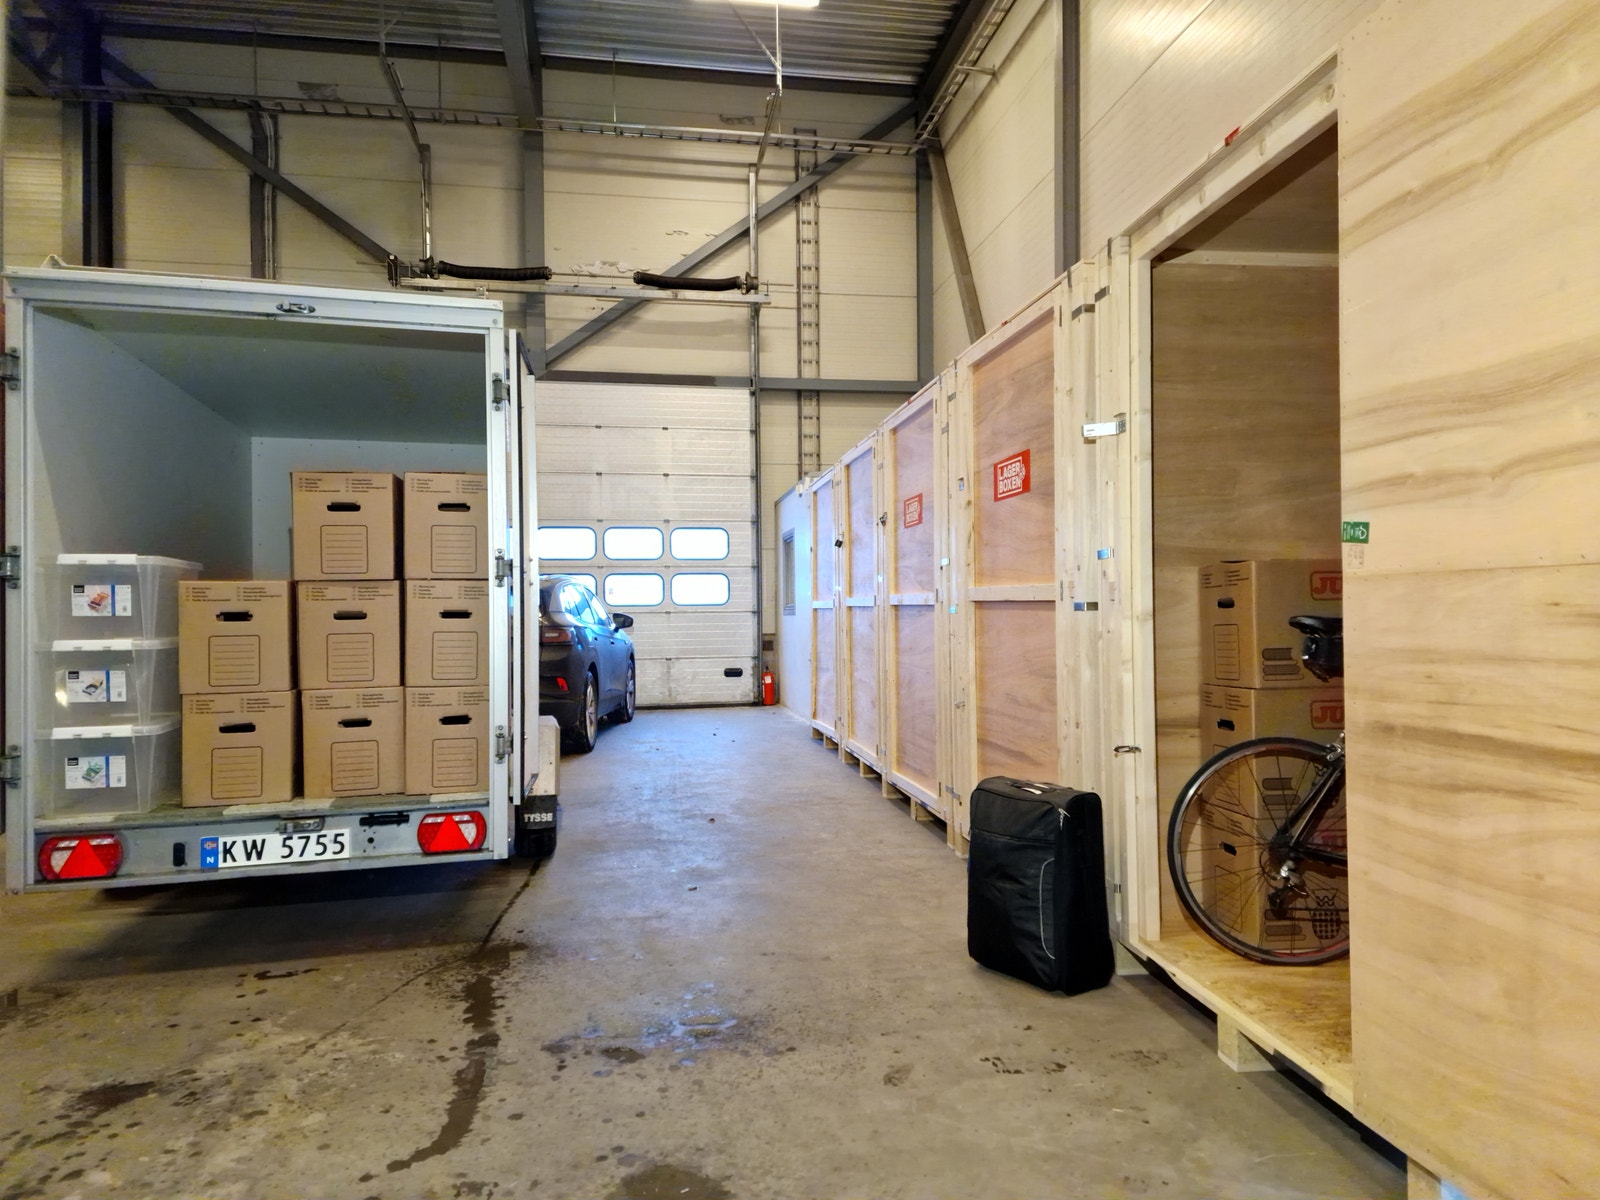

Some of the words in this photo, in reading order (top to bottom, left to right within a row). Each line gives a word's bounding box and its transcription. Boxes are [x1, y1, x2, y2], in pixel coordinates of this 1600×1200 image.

[999, 462, 1020, 480] LAGER
[999, 476, 1021, 493] BOXEN
[524, 813, 553, 822] TYSSE
[222, 838, 266, 863] KW
[280, 833, 345, 859] 5755
